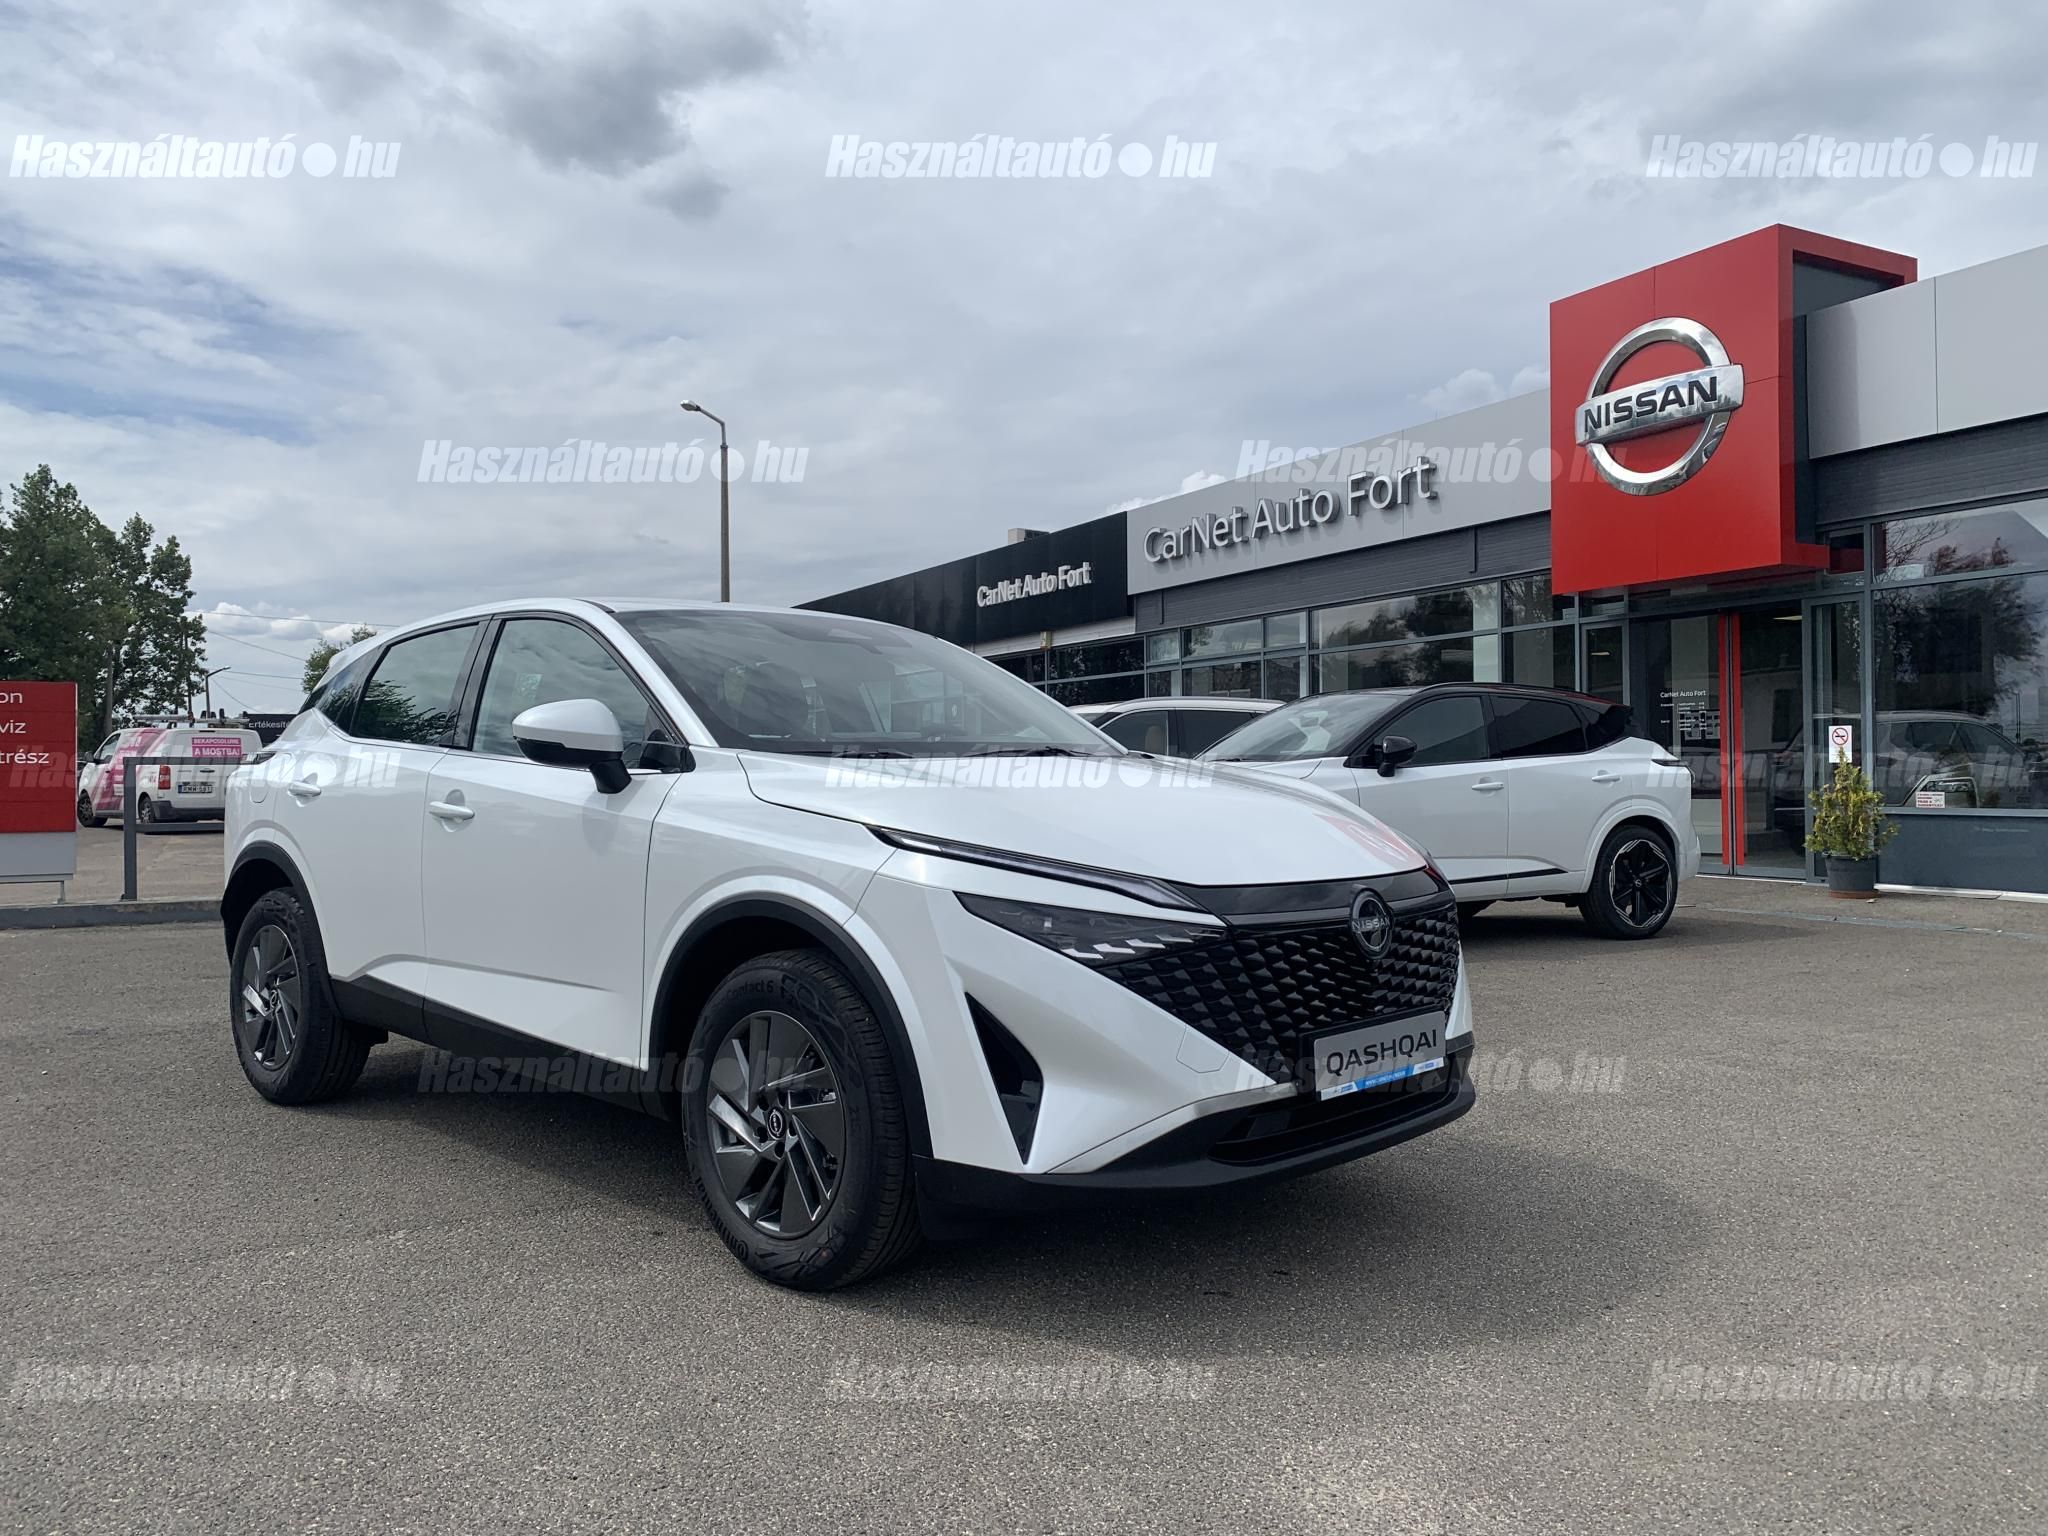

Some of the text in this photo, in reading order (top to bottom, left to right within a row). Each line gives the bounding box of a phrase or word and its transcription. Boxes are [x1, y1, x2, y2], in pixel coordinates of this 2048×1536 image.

[1584, 376, 1717, 433] NISSAN
[1144, 456, 1438, 563] CarNet Auto Fort
[977, 562, 1092, 608] CarNet Auto Fort
[1351, 916, 1391, 931] NISSAN
[1326, 1029, 1437, 1076] QASHQAI
